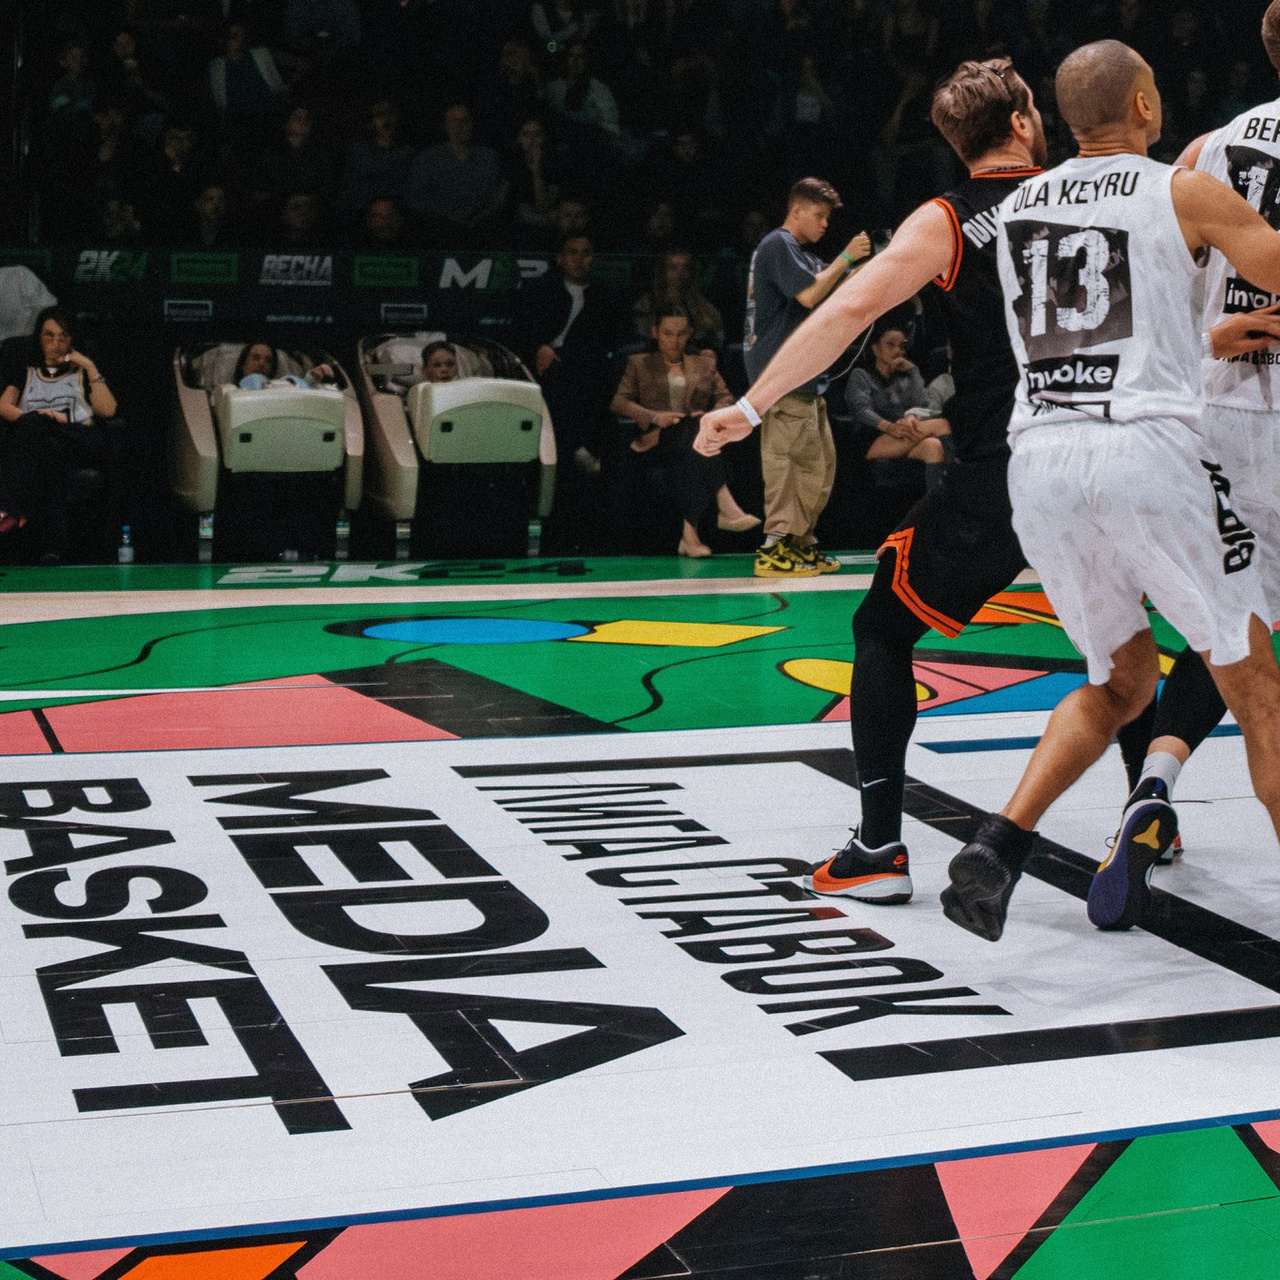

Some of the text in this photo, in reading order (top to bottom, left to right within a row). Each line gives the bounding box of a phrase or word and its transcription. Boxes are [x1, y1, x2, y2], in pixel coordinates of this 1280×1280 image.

[1057, 171, 1140, 206] KEYRU
[1021, 229, 1111, 337] 13
[1026, 360, 1113, 389] nvoke
[0, 776, 354, 1136] BASKET
[185, 767, 688, 1122] MEDIA
